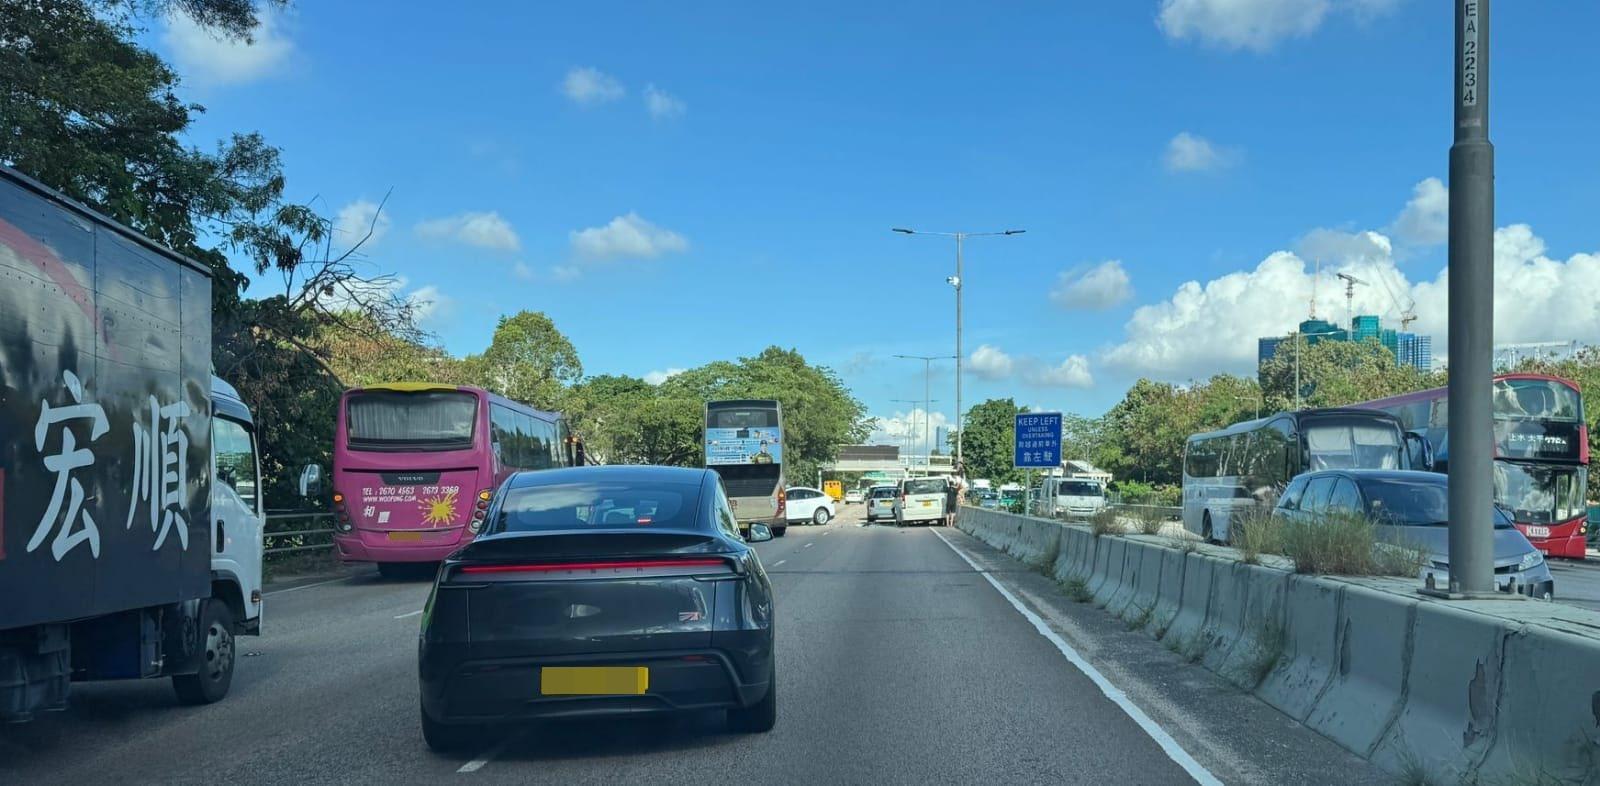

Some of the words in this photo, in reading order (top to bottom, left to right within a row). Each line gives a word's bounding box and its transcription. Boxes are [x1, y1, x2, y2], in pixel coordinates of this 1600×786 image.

[1464, 41, 1476, 103] 2234
[1018, 417, 1039, 426] KEEP
[1040, 416, 1058, 425] LEFT
[1509, 433, 1526, 442] 上水
[26, 368, 190, 563] 宏順
[379, 486, 396, 495] 2670
